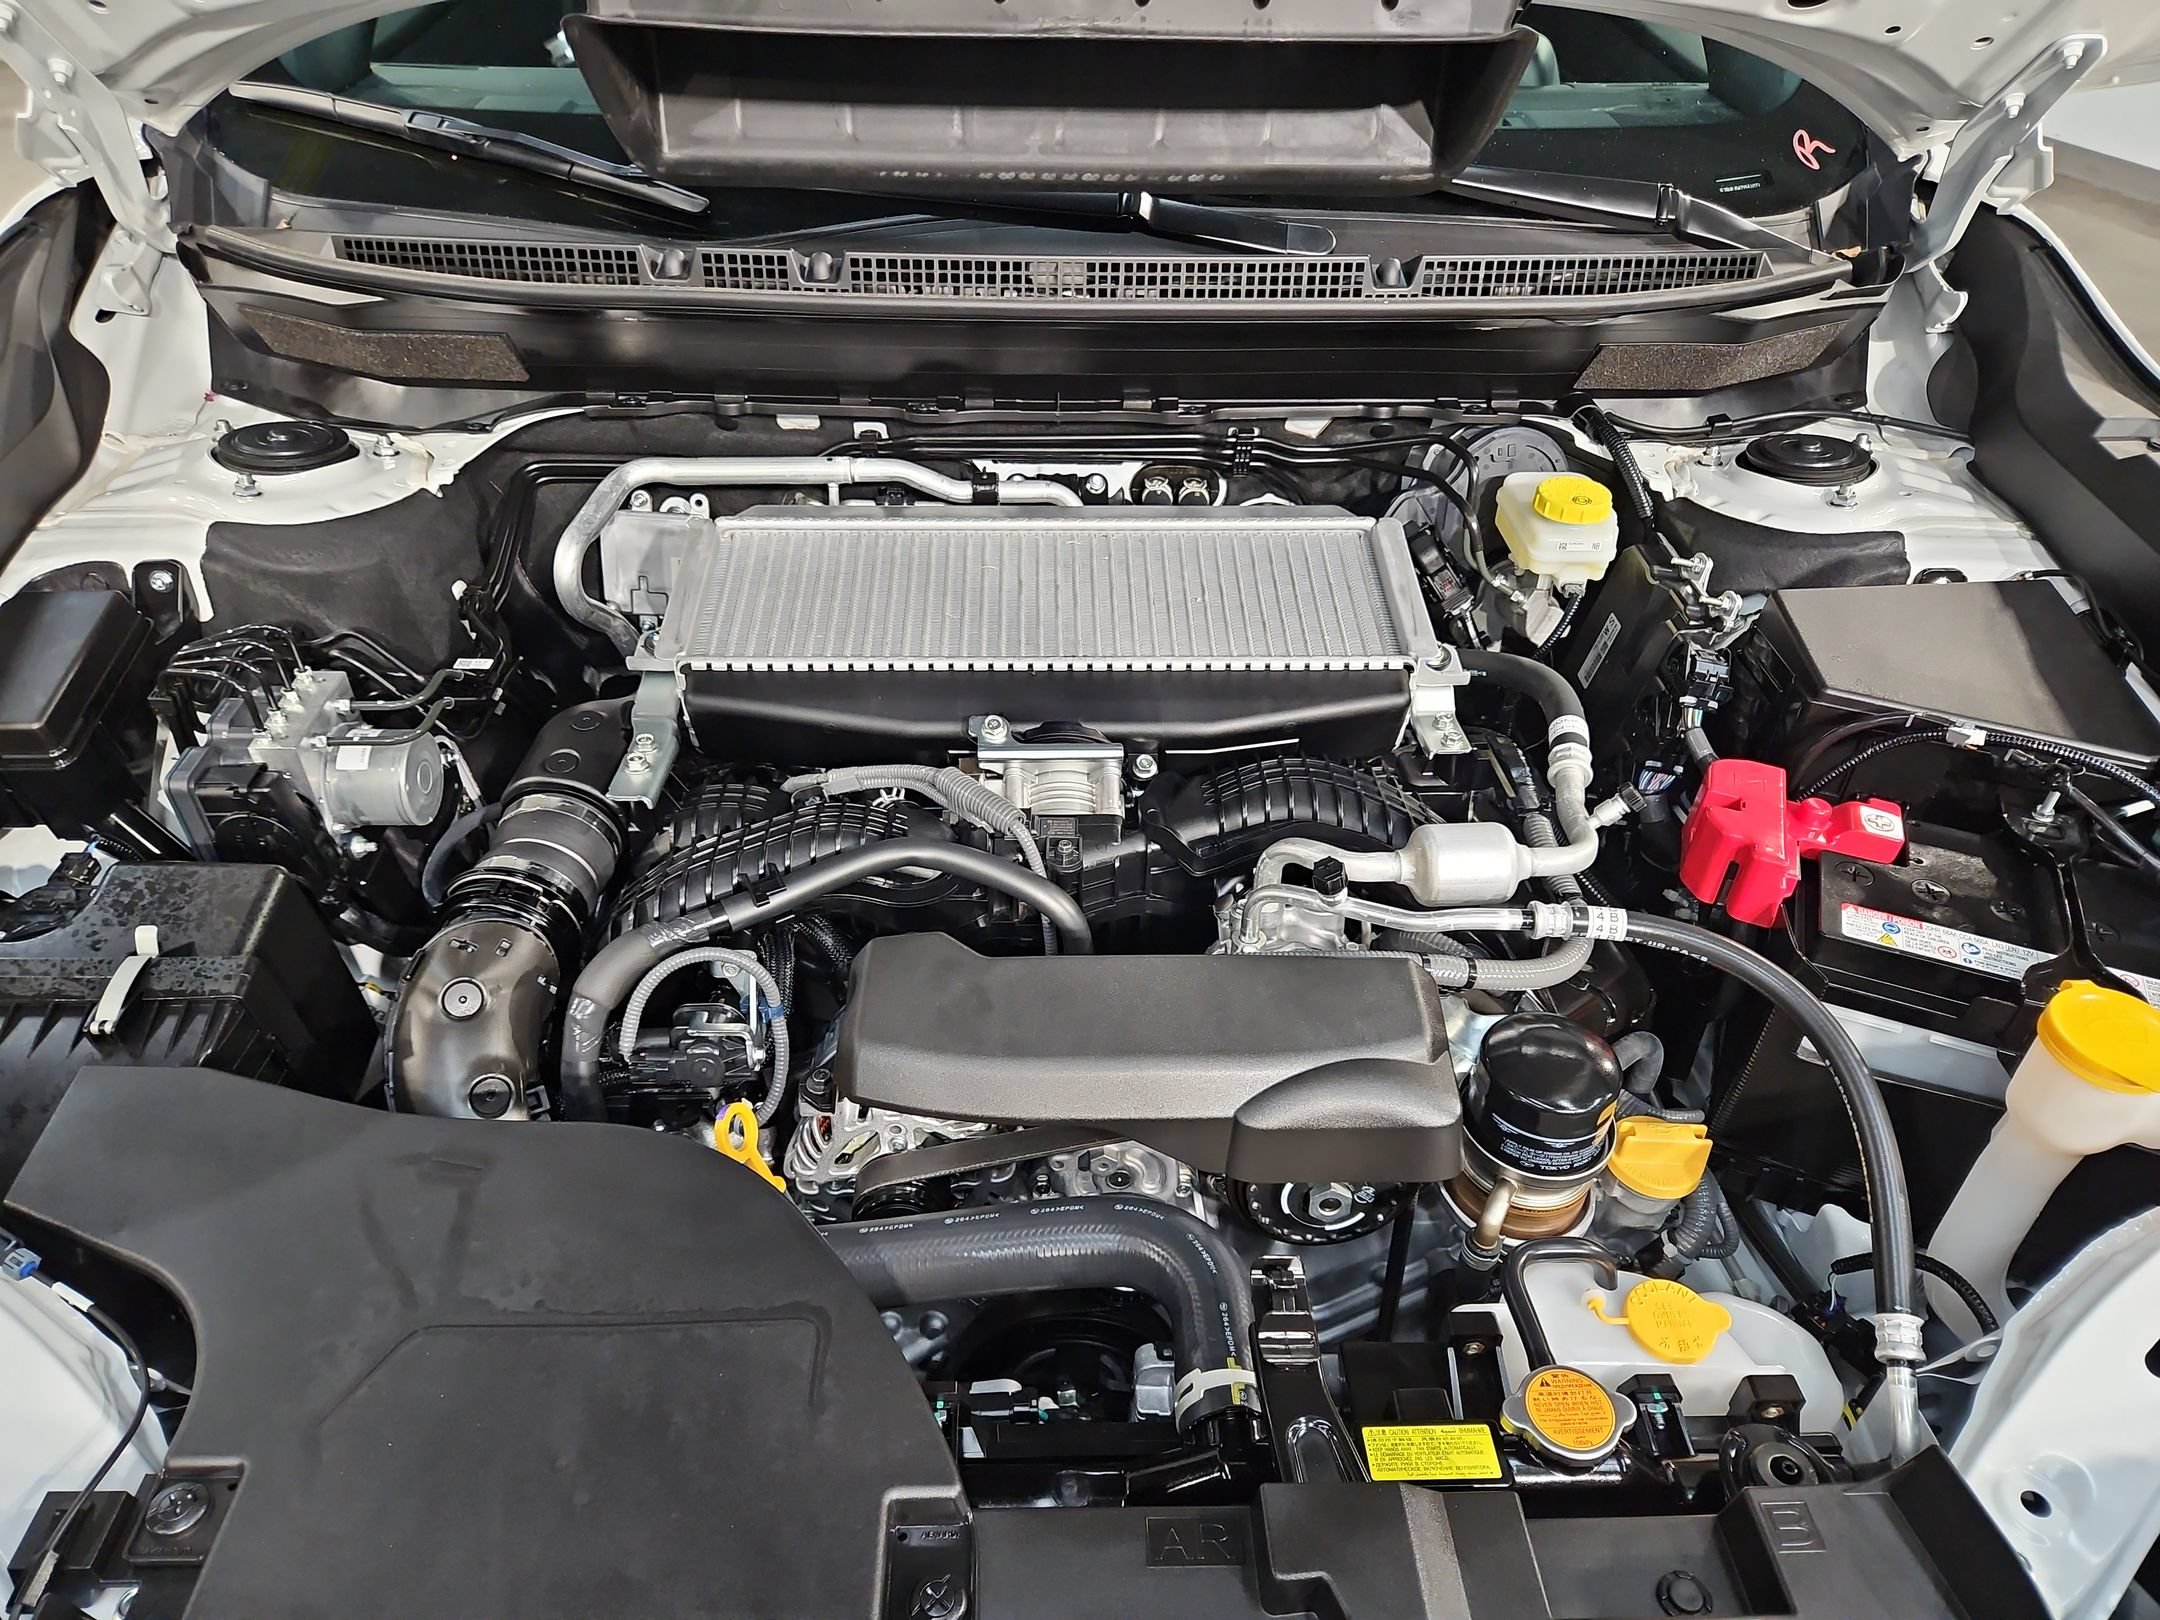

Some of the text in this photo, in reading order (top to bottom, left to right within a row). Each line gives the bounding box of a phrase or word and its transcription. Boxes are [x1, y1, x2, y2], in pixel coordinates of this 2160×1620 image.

[1793, 129, 1836, 170] R
[1597, 912, 1619, 922] 4 B
[1610, 925, 1619, 933] B
[1630, 1282, 1696, 1305] COOLANT
[1156, 1524, 1232, 1560] AR
[1772, 1510, 1816, 1546] B
